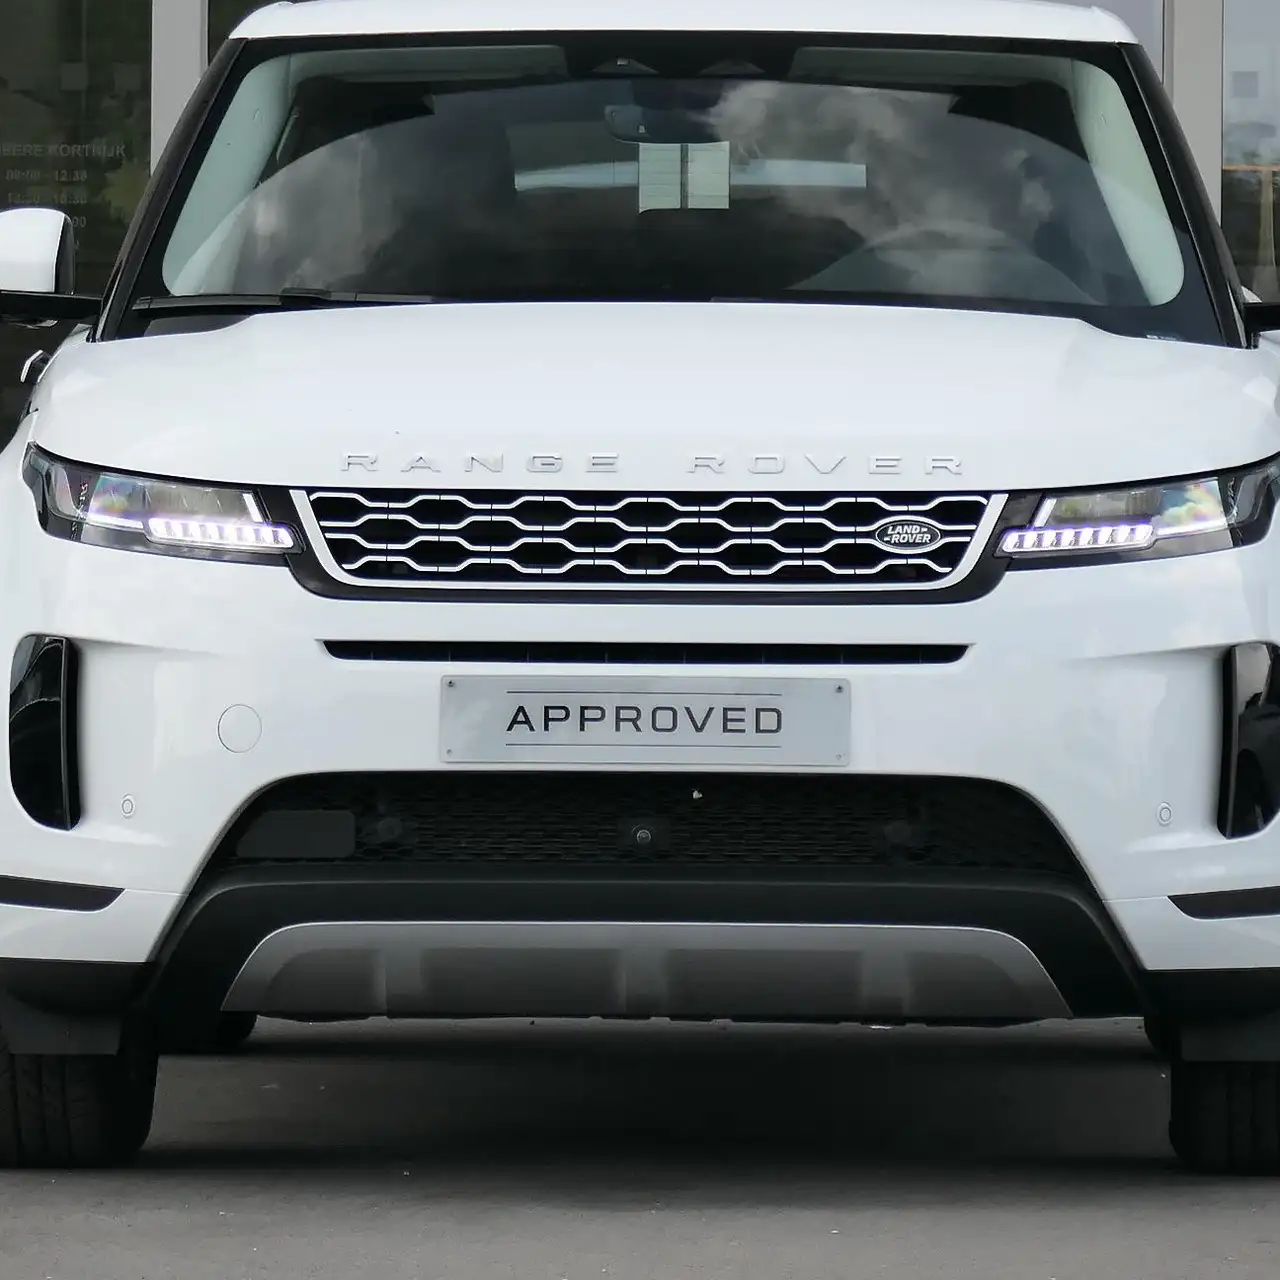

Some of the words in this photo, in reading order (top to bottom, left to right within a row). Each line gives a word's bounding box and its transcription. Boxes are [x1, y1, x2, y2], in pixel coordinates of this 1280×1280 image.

[340, 452, 620, 473] RANGE
[686, 453, 964, 475] ROVER
[887, 524, 921, 535] LAND
[890, 533, 932, 544] ROVER
[505, 704, 784, 735] APPROVED
